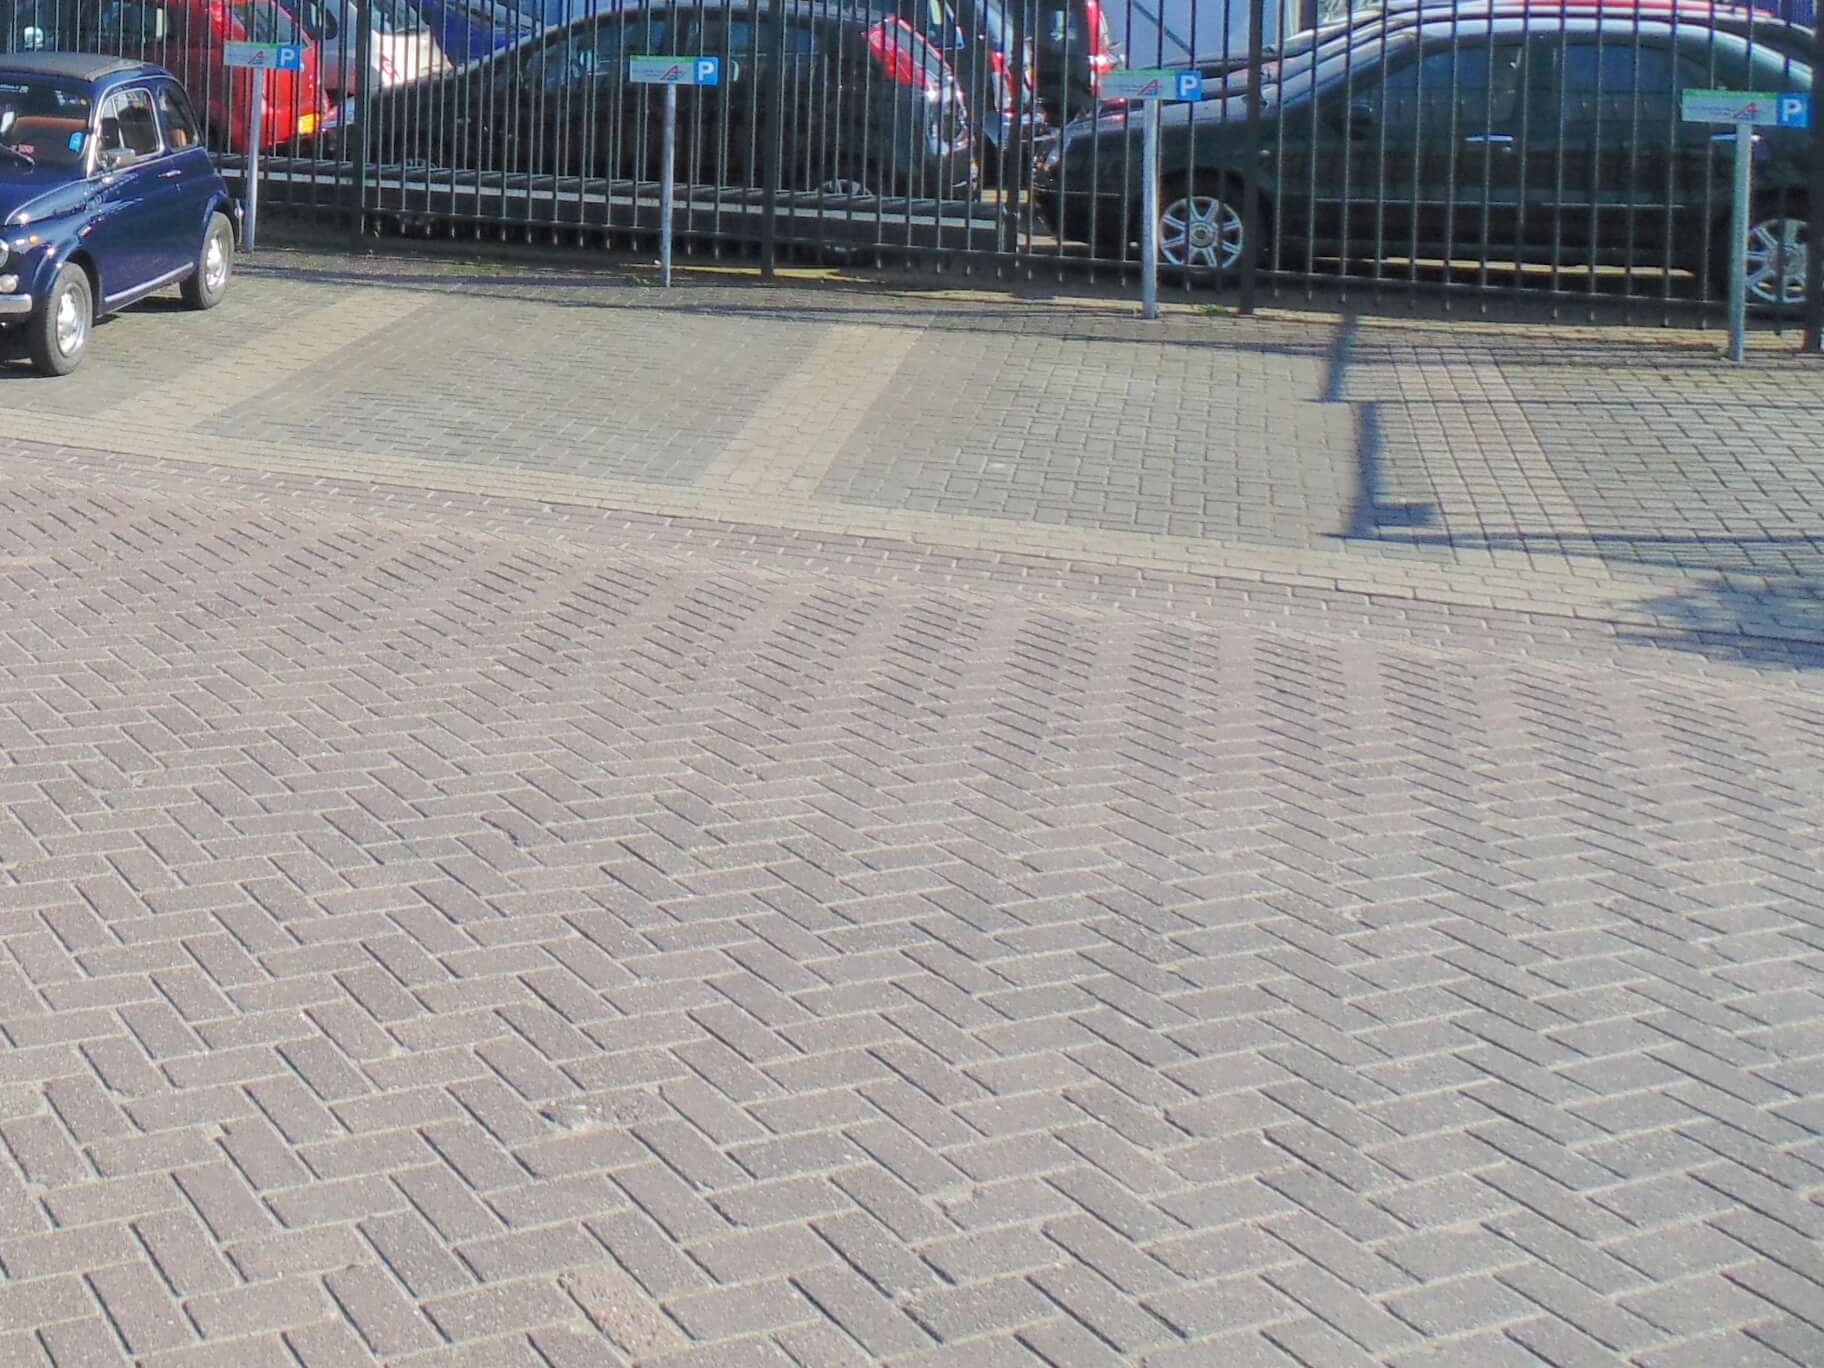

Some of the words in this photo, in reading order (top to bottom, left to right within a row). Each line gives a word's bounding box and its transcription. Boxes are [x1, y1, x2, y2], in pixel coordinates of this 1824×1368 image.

[280, 48, 295, 66] P
[698, 61, 714, 80] P
[1180, 75, 1197, 96] P
[1782, 99, 1802, 121] P
